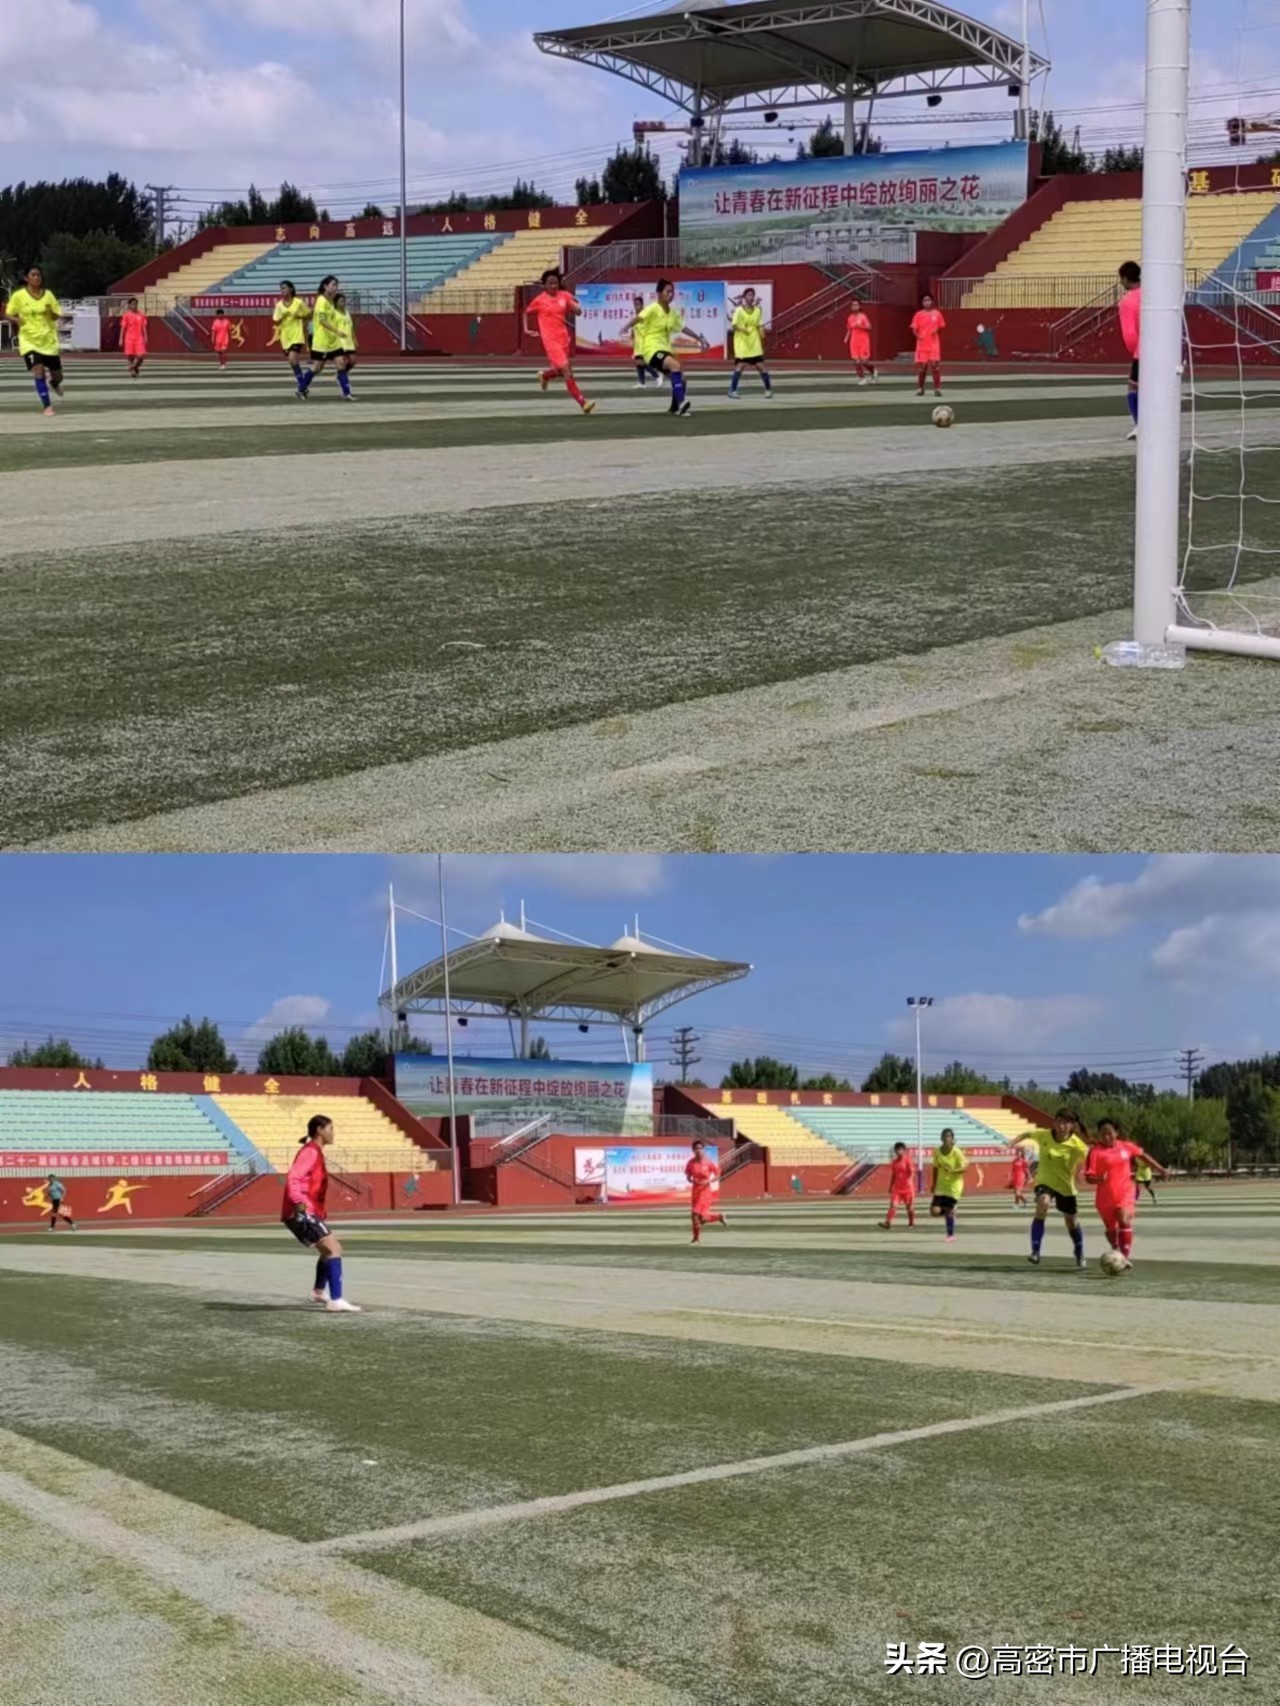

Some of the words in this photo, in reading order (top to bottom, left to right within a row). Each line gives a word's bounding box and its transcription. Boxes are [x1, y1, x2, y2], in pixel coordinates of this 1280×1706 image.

[714, 175, 981, 214] 让青春在新征程中绽放绚丽之花
[441, 207, 588, 234] 人格健全
[73, 1071, 281, 1094] 人格健全
